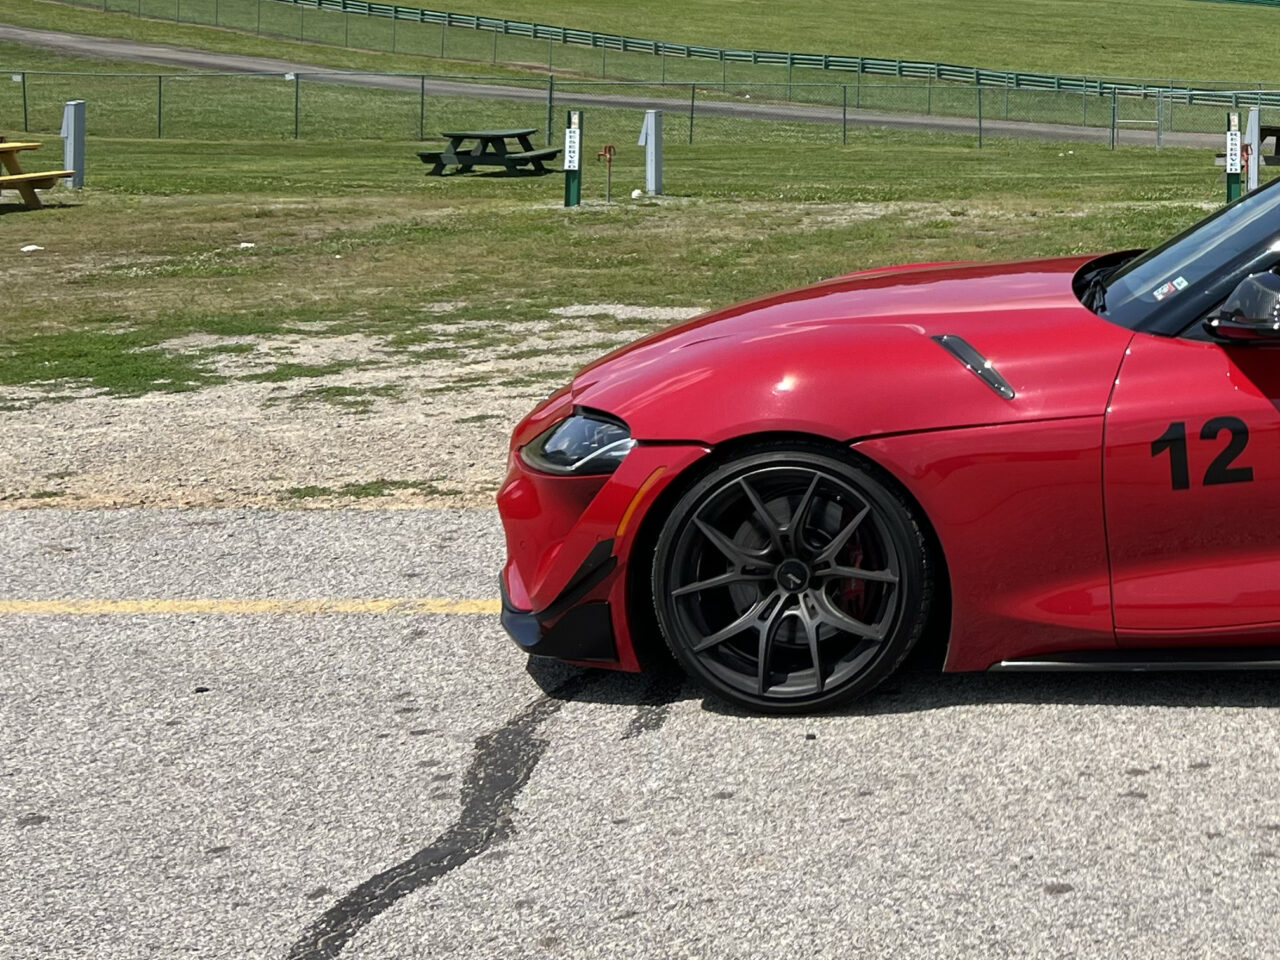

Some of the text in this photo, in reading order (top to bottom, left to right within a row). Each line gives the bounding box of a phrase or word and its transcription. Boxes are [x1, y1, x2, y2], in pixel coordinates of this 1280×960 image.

[567, 129, 577, 169] RESERVED
[1229, 132, 1239, 172] RESERVED
[1151, 416, 1254, 491] 12
